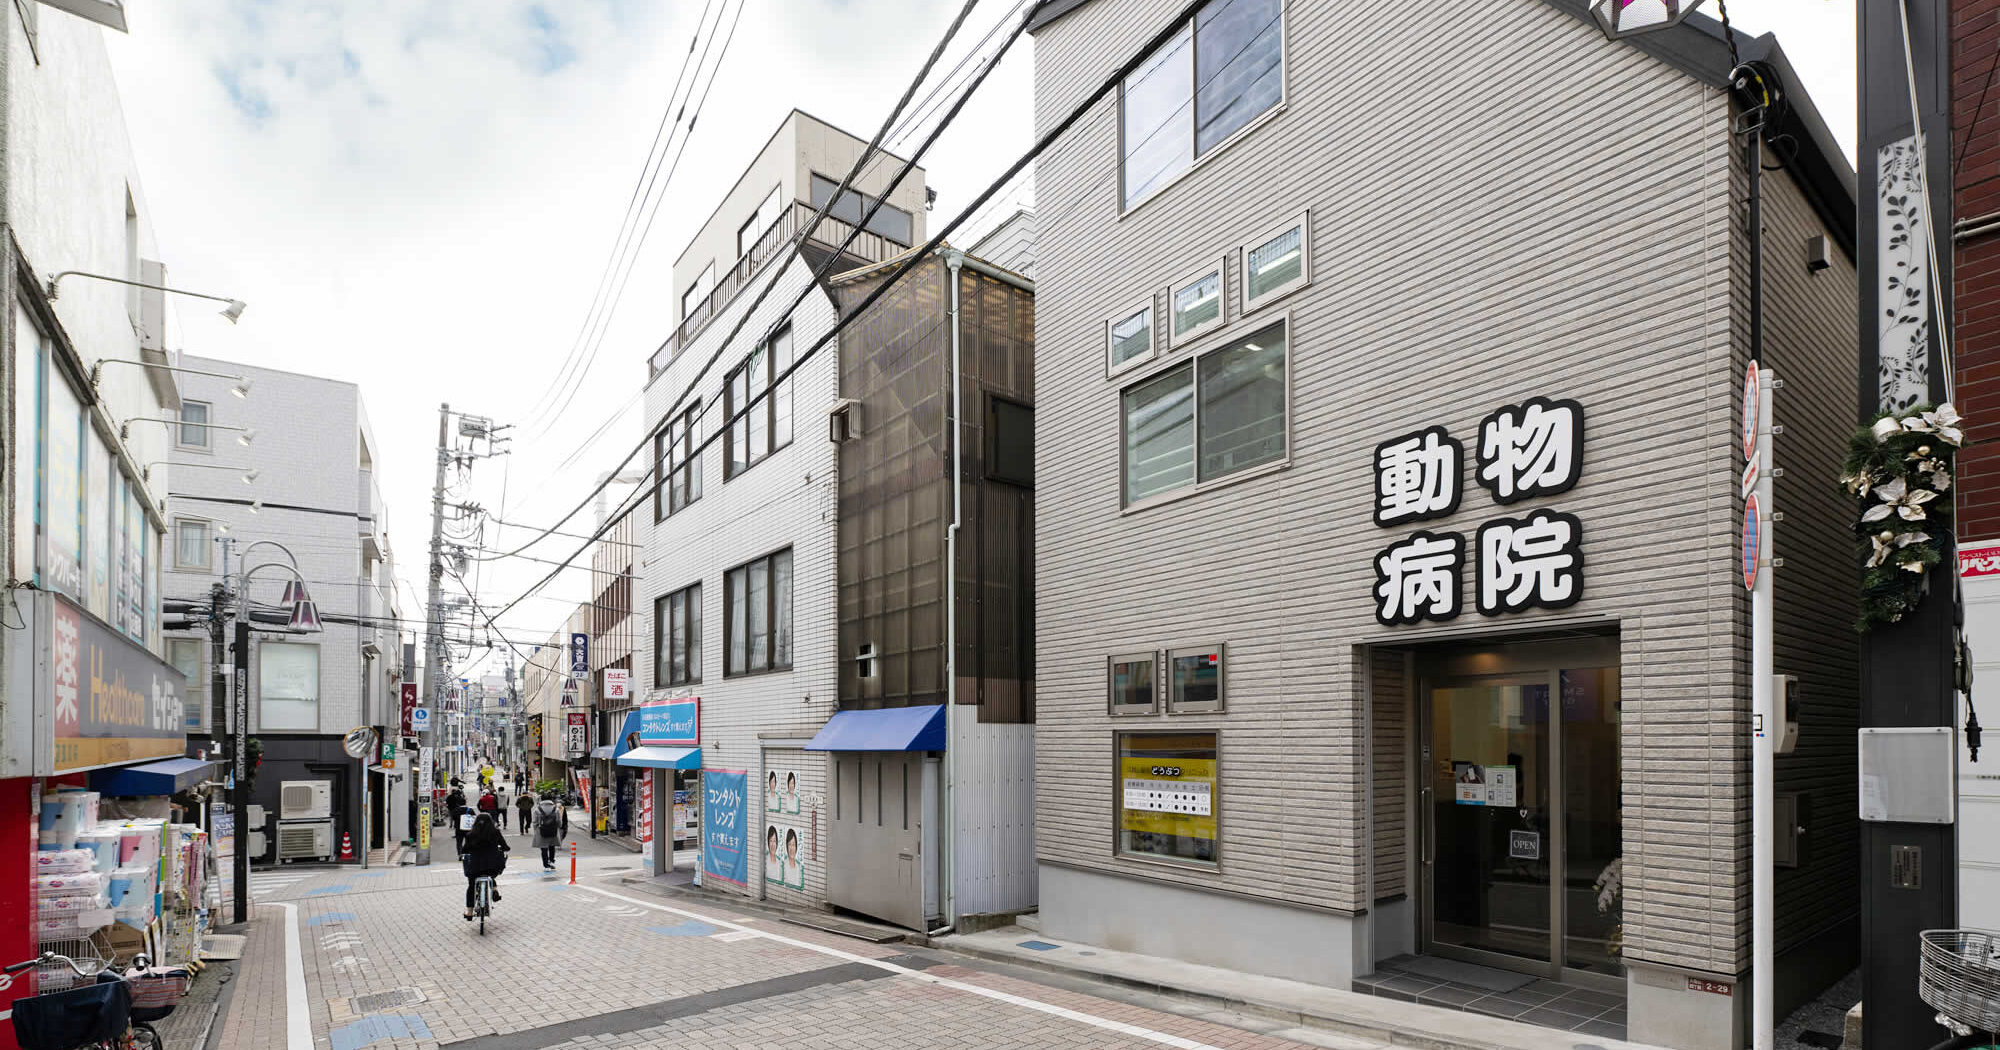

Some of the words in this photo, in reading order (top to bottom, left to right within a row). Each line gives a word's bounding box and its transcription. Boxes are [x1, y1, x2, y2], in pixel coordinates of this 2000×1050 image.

[1376, 399, 1579, 525] 動物
[1376, 512, 1579, 622] 病院
[56, 615, 77, 725] 薬
[611, 685, 624, 696] 酒
[642, 720, 671, 733] コンタクトレンズ
[1152, 766, 1180, 776] どうぶつ
[709, 788, 741, 808] コンタクト
[714, 809, 736, 829] レンズ
[711, 832, 739, 848] すぐ買えます
[1513, 840, 1537, 850] OPEN
[1706, 983, 1728, 993] 2-29
